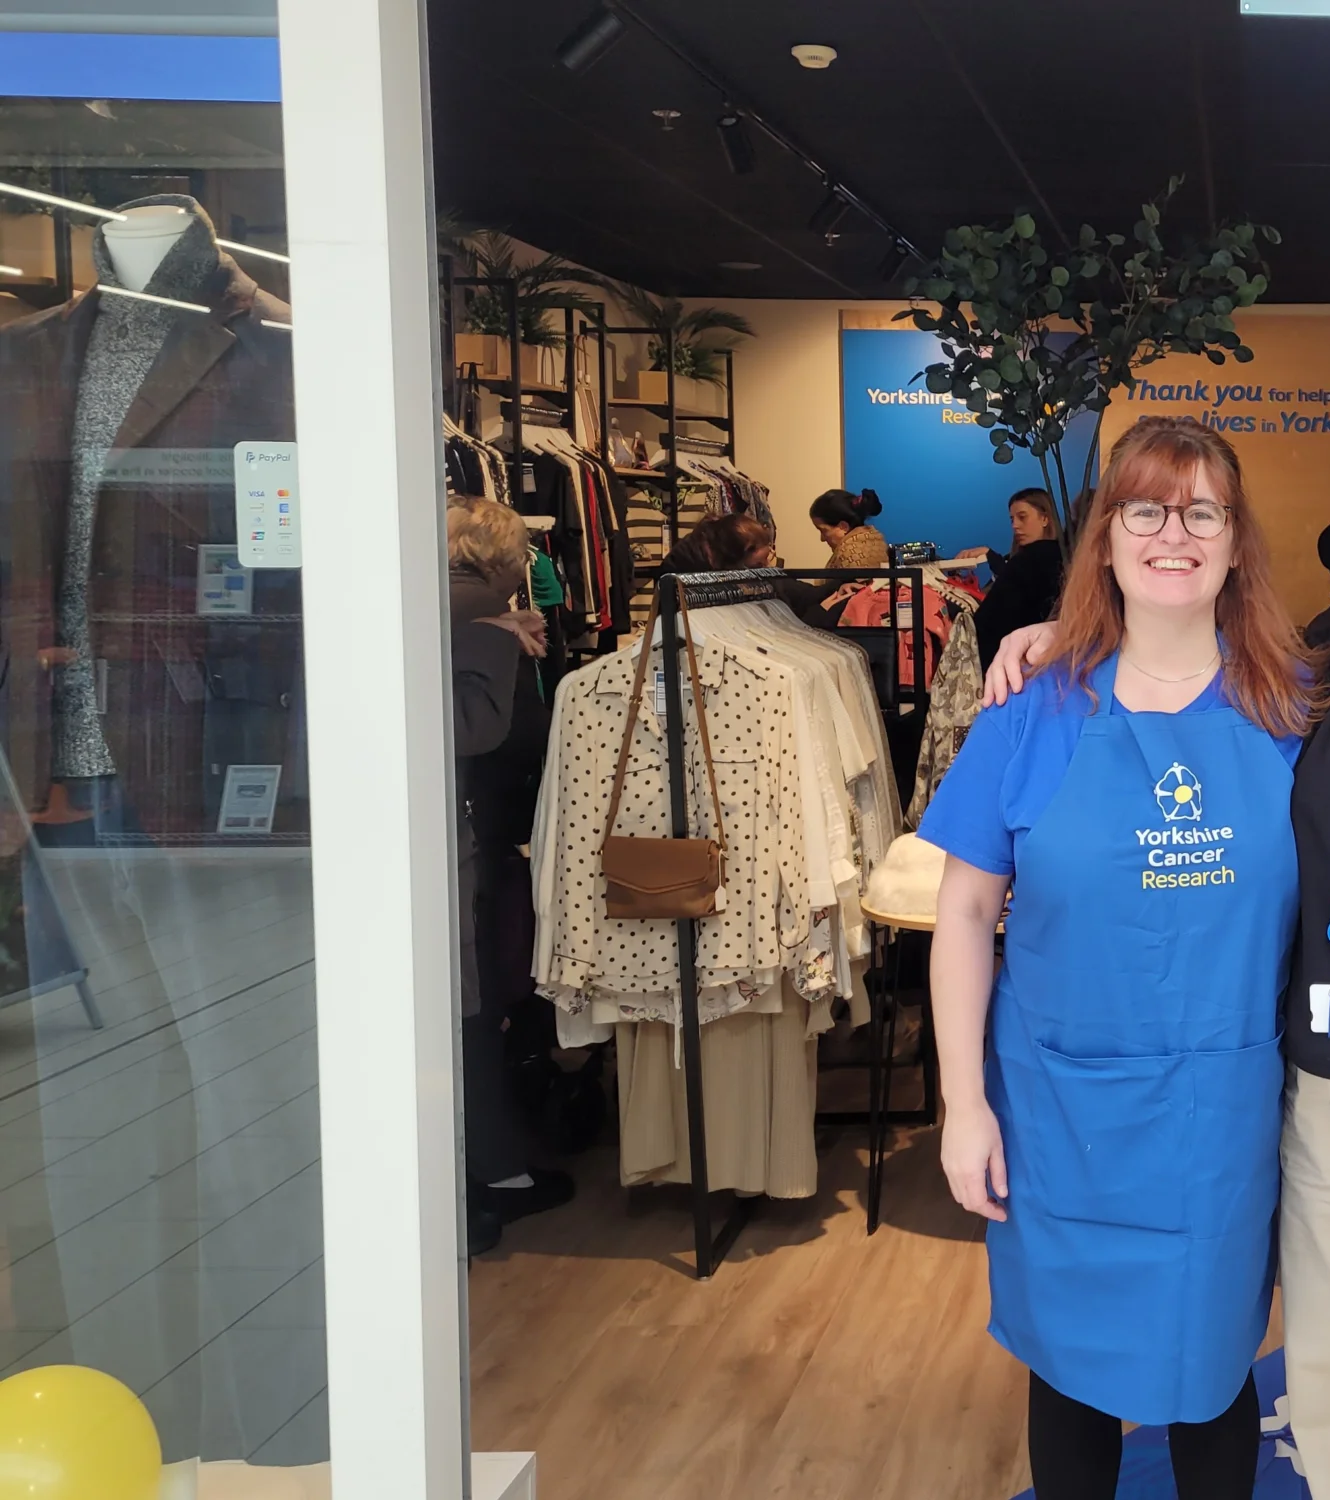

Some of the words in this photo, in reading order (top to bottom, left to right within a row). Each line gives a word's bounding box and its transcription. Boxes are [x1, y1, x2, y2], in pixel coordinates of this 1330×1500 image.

[867, 388, 953, 405] Yorkshire
[1128, 378, 1210, 401] Thank
[1212, 384, 1263, 407] you
[1268, 388, 1294, 402] for
[1201, 410, 1257, 432] lives
[1261, 419, 1278, 432] in
[259, 453, 291, 462] PayPal
[1135, 826, 1234, 846] Yorkshire
[1148, 847, 1225, 867] Cancer
[1142, 865, 1235, 889] Research
